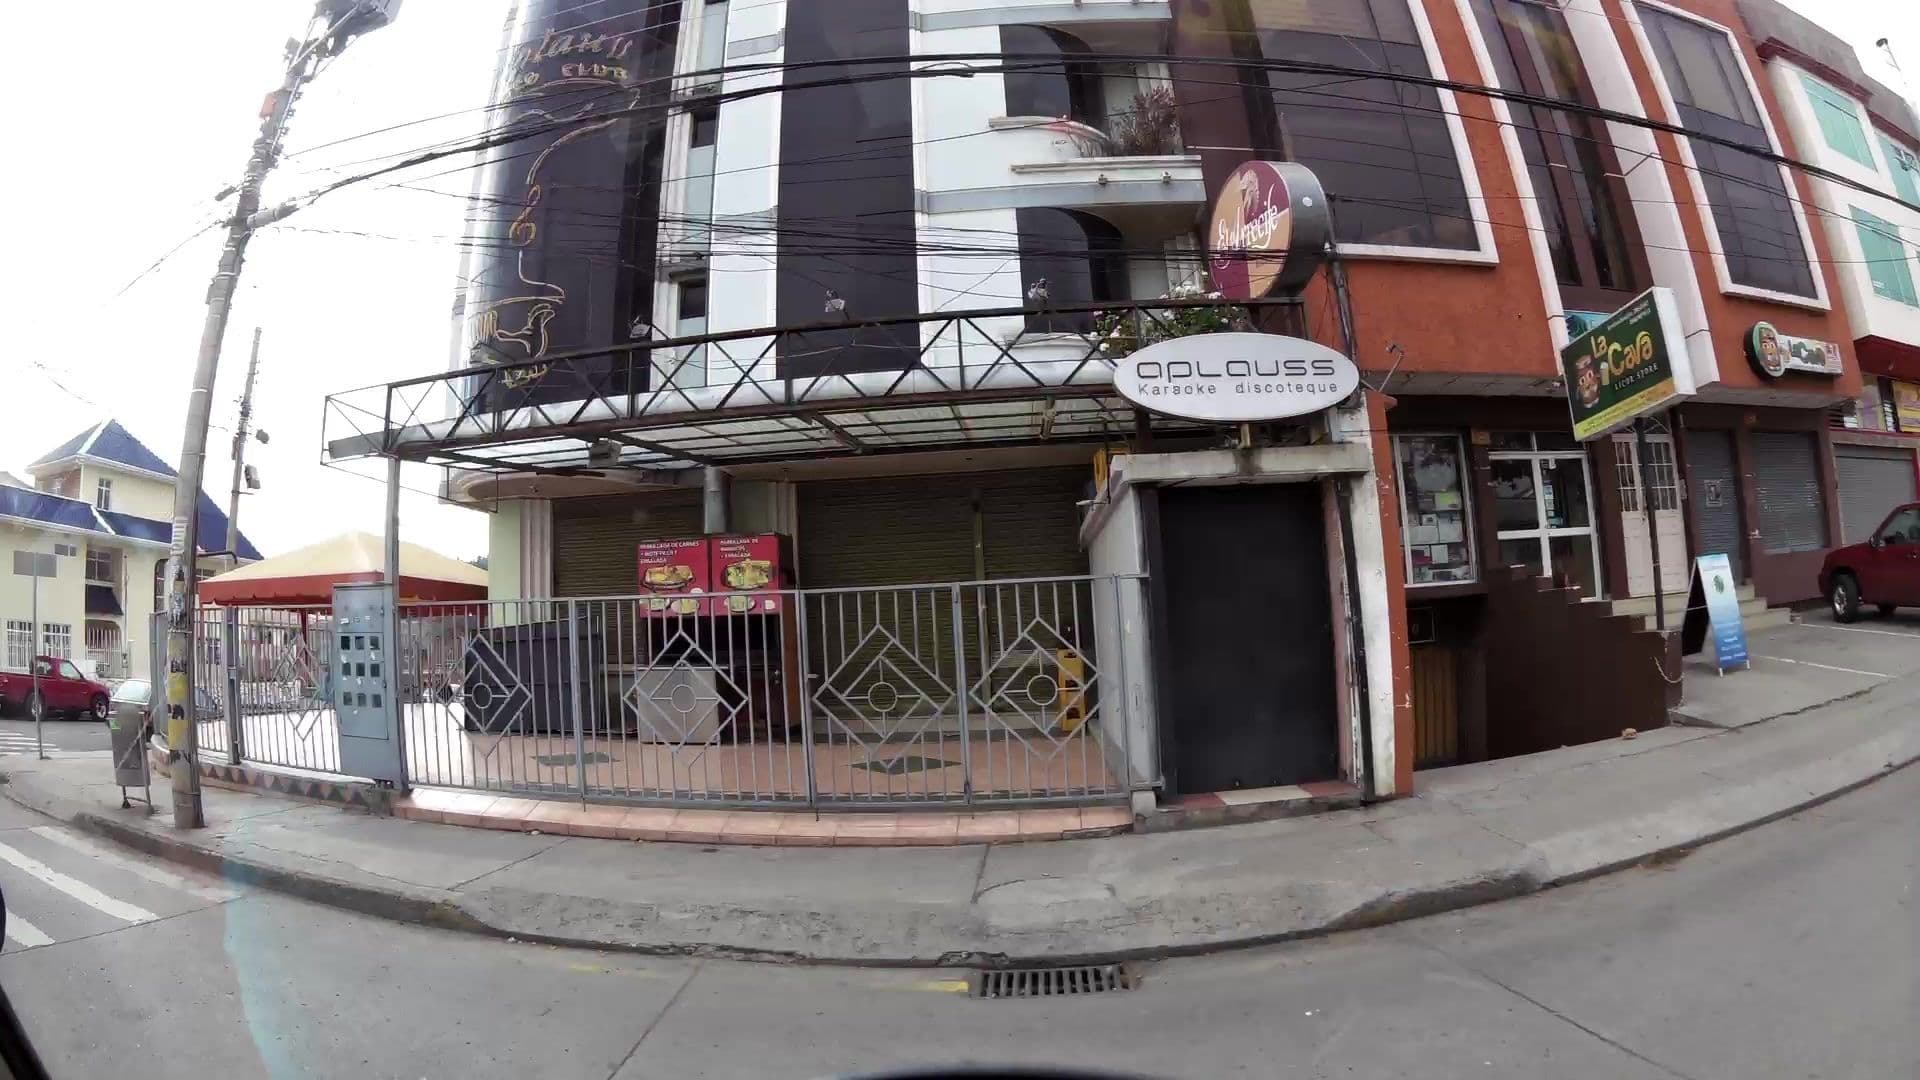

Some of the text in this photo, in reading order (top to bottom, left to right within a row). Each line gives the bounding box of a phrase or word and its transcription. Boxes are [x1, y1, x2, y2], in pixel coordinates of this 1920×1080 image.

[1590, 335, 1608, 359] La
[1607, 331, 1654, 376] Cava
[1138, 381, 1338, 396] Karaoke discoteque
